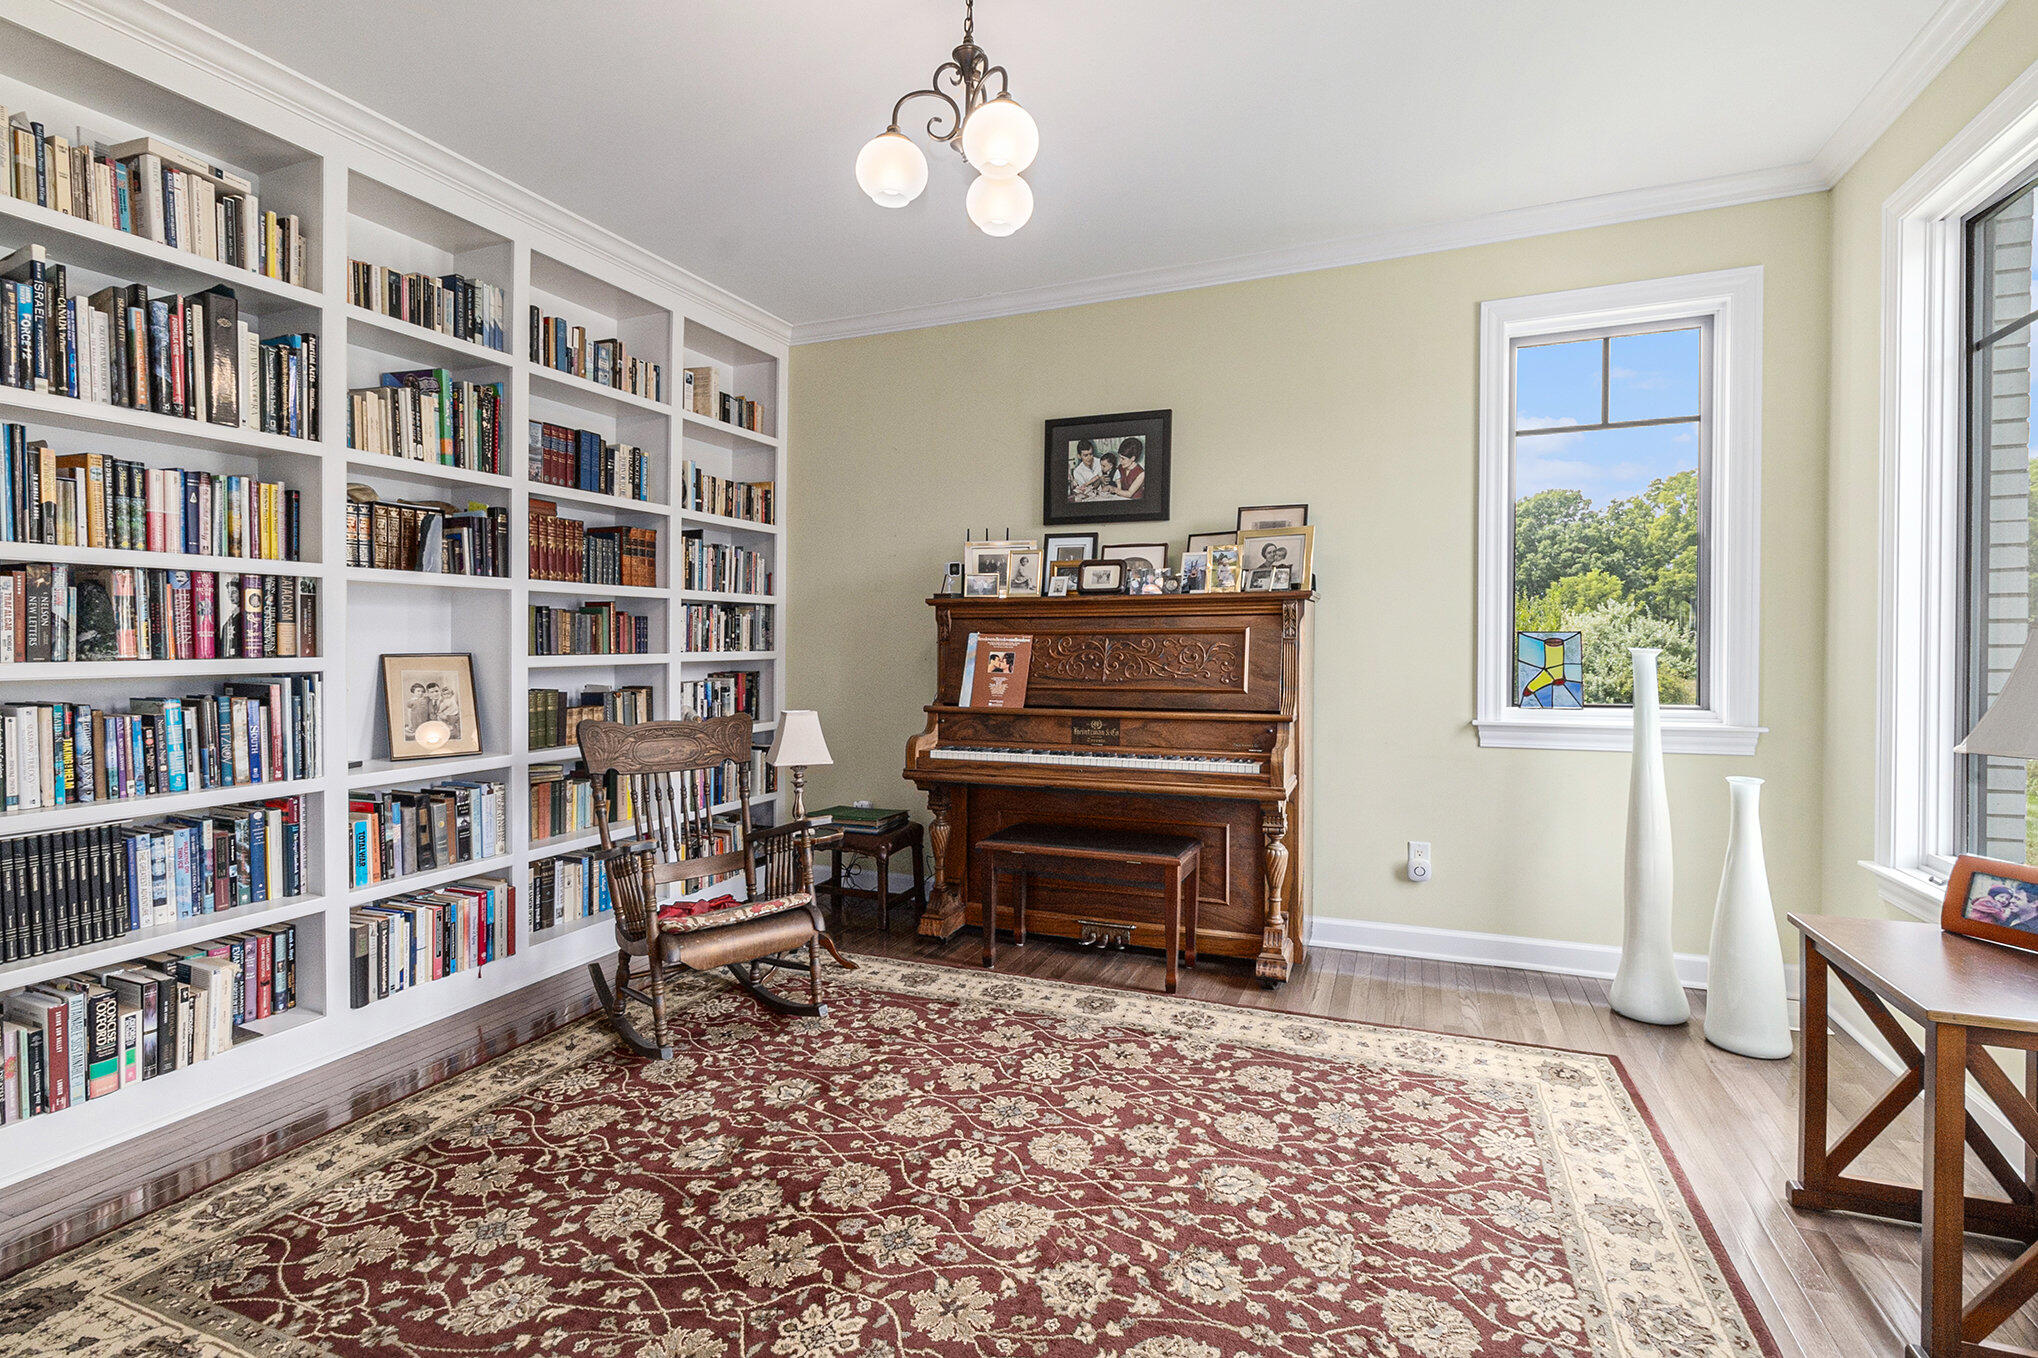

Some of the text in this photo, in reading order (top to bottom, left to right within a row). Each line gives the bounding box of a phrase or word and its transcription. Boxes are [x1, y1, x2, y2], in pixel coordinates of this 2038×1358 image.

[34, 280, 45, 322] ISRAEL
[58, 297, 67, 331] CANADA
[21, 313, 32, 345] FORCE
[105, 459, 111, 467] TO
[41, 596, 49, 627] NELSON
[281, 576, 294, 621] CATACLYSM
[28, 596, 37, 647] NEW LETTERS
[63, 738, 73, 764] TAKING
[220, 723, 232, 765] FITZROY
[250, 725, 259, 754] SOUTH
[64, 768, 74, 789] HELM
[358, 831, 367, 868] TOTAL WAR
[139, 864, 147, 887] GREATEST
[96, 1003, 107, 1046] OXFORD
[106, 1000, 116, 1044] CONCISE
[70, 1000, 84, 1081] ATTAINABLE SUSTAINABLE
